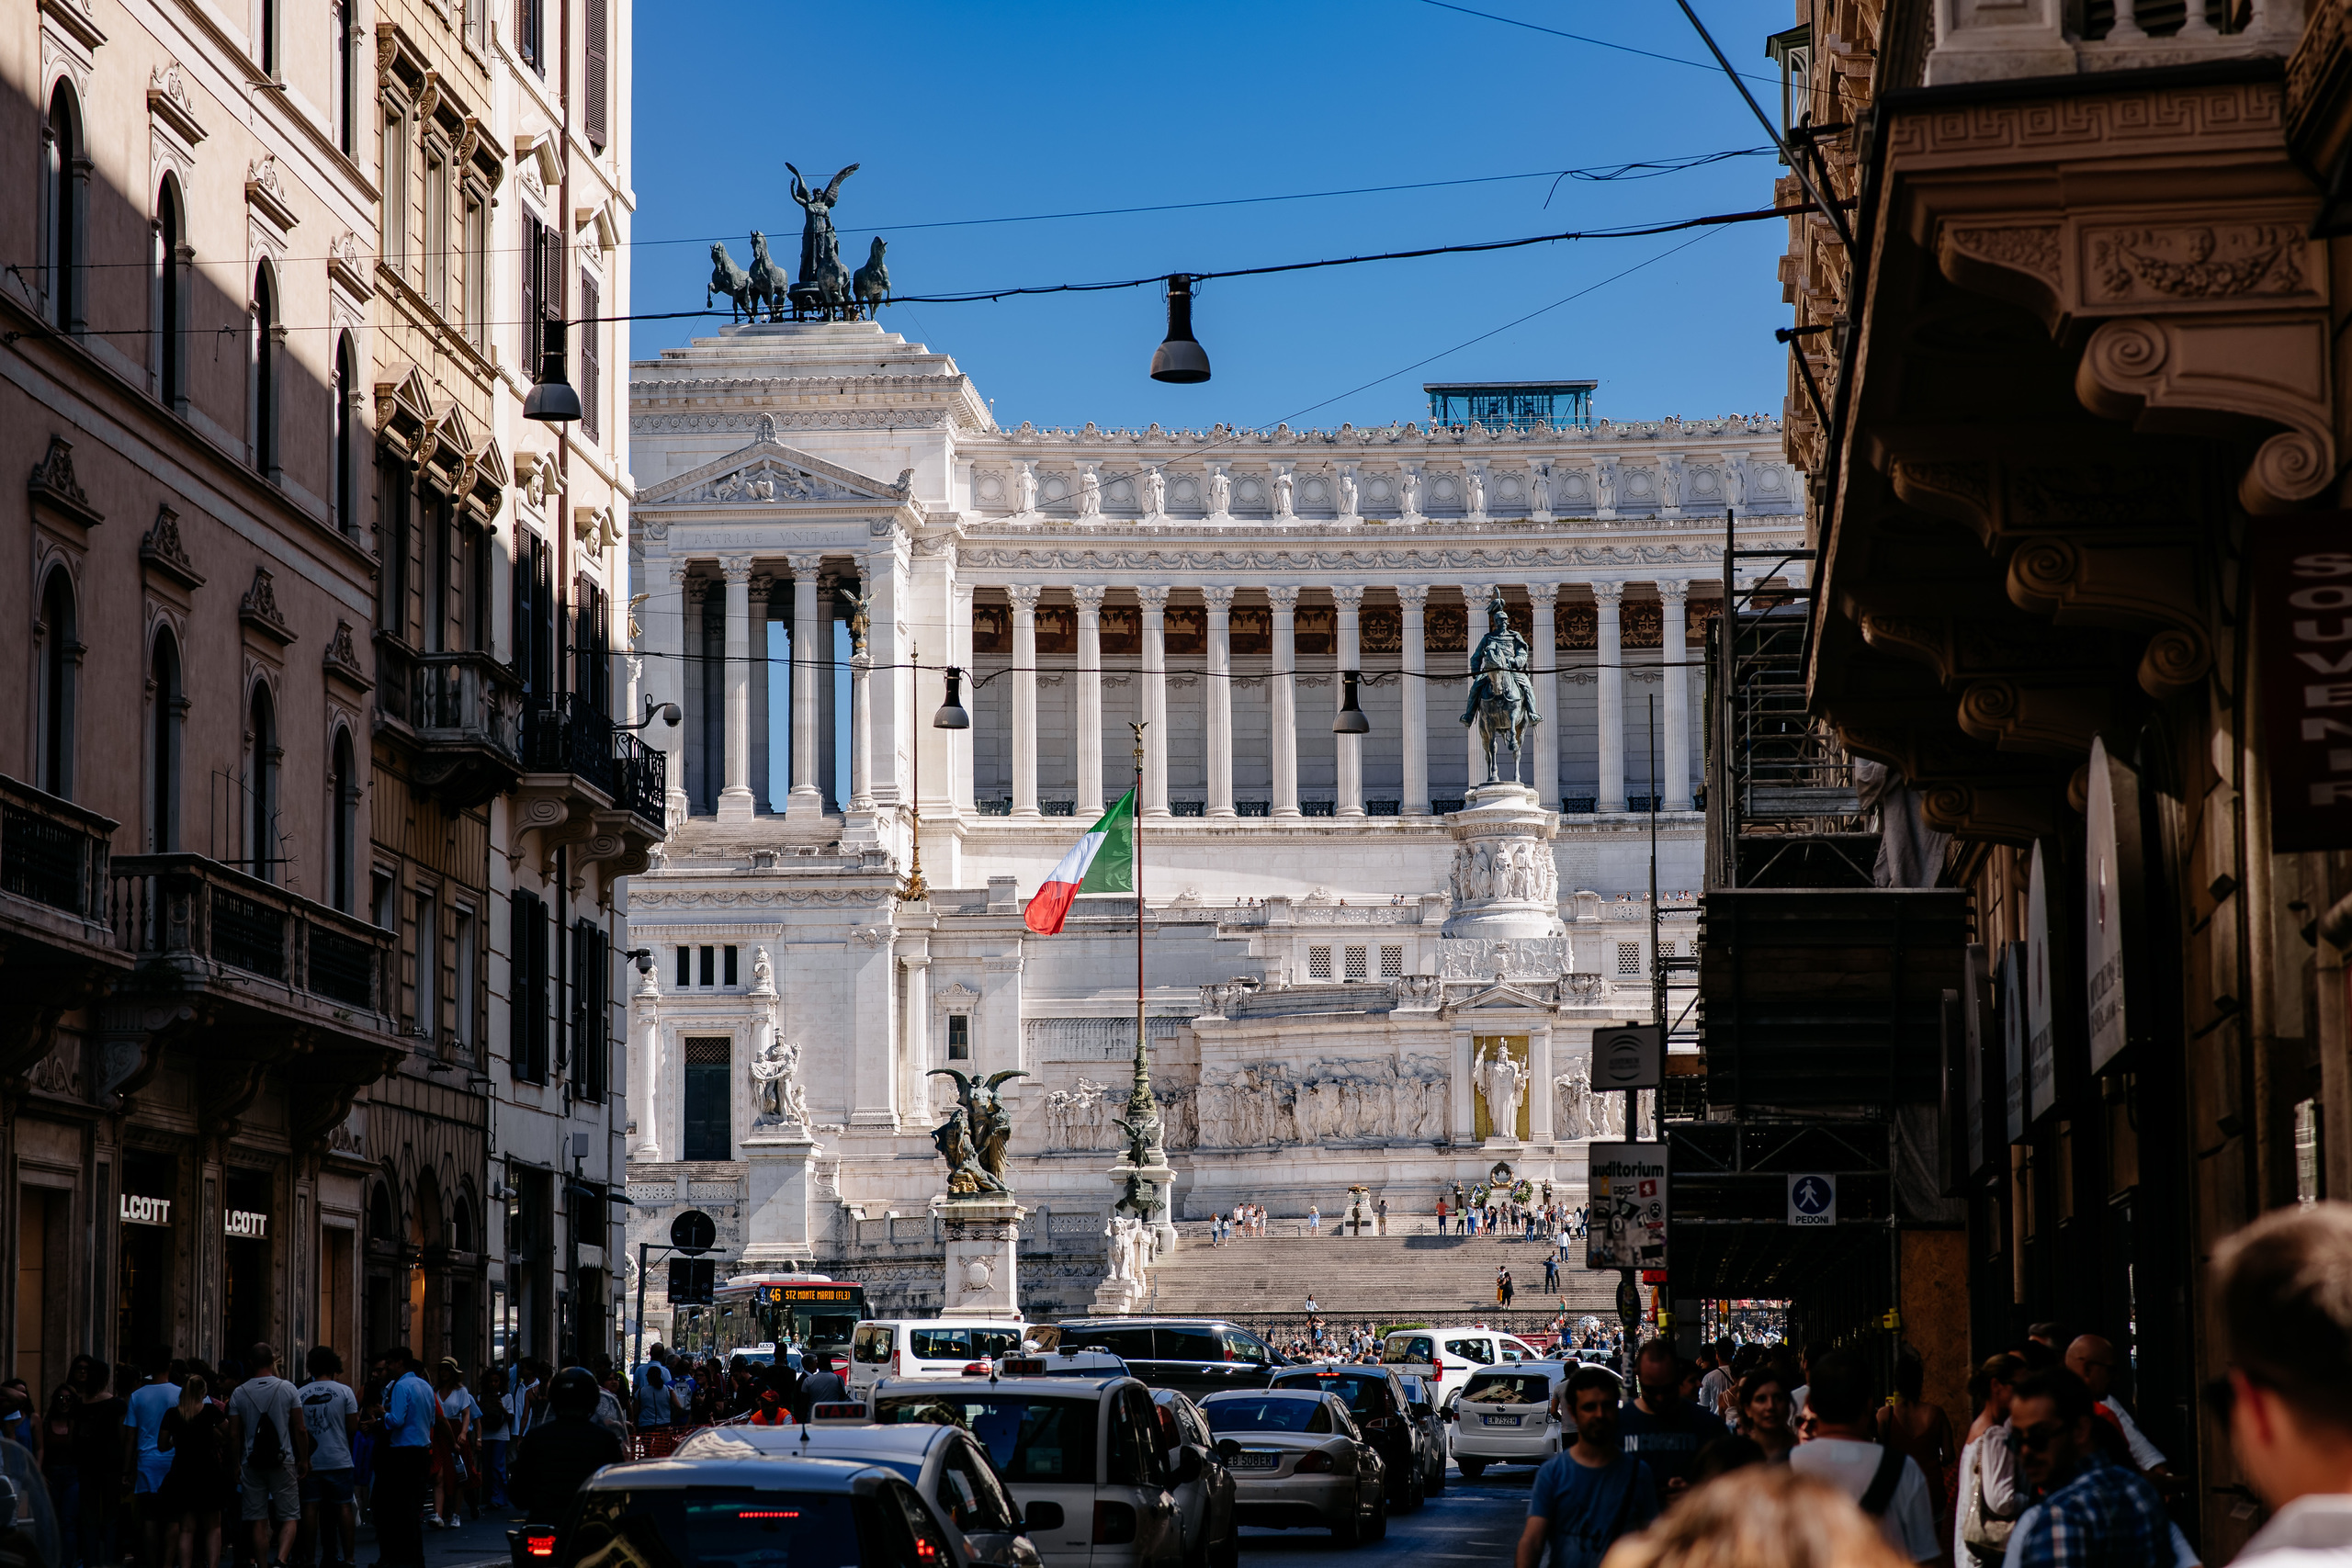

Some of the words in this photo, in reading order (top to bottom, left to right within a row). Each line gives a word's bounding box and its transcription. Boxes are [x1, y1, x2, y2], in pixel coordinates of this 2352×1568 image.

[695, 532, 763, 544] PATRIAE
[1591, 1161, 1664, 1178] auditorium
[1795, 1215, 1829, 1224] PEDONI
[769, 1288, 781, 1302] 46
[797, 1290, 816, 1300] MONTE
[817, 1290, 835, 1300] MARIO
[835, 1290, 851, 1301] (FL3)
[1006, 1360, 1042, 1373] TAXI
[816, 1404, 864, 1418] TAXI
[1487, 1416, 1496, 1424] EN
